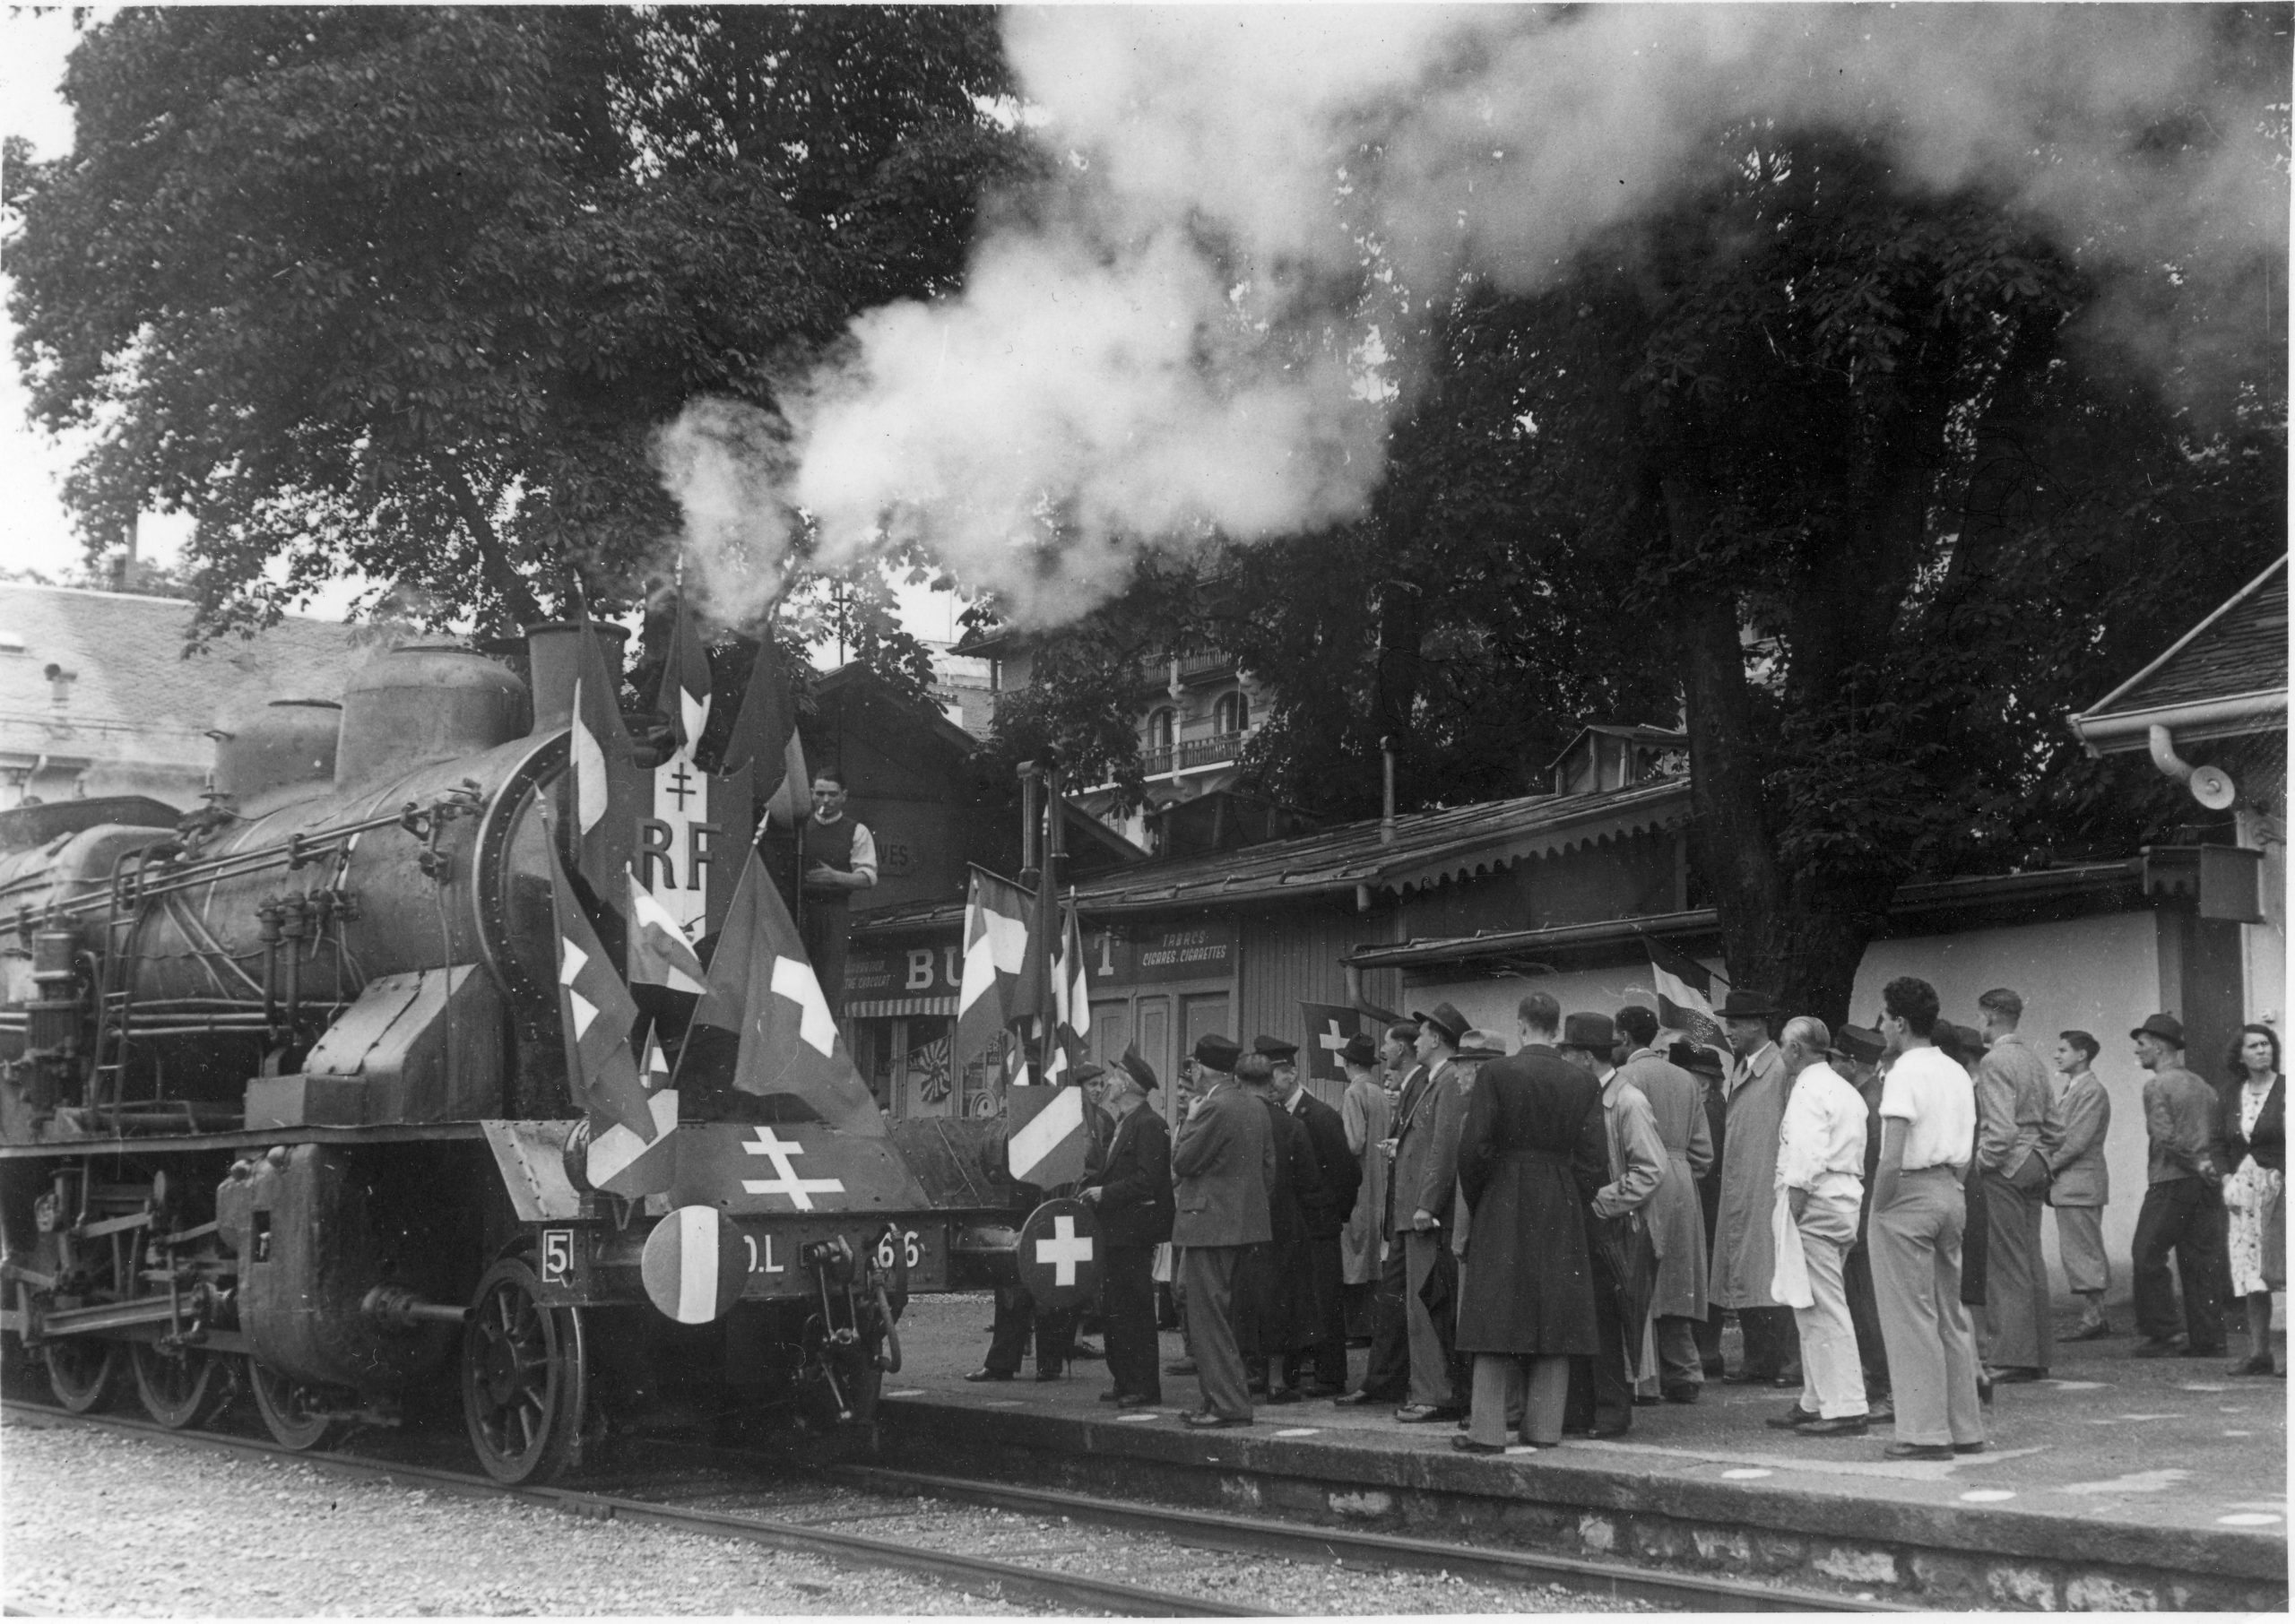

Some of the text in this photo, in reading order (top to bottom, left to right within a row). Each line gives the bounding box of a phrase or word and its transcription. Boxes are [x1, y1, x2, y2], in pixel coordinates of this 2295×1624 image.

[632, 817, 723, 892] RF
[877, 843, 909, 867] VES
[905, 933, 1120, 989] BUT
[547, 1234, 568, 1274] 5
